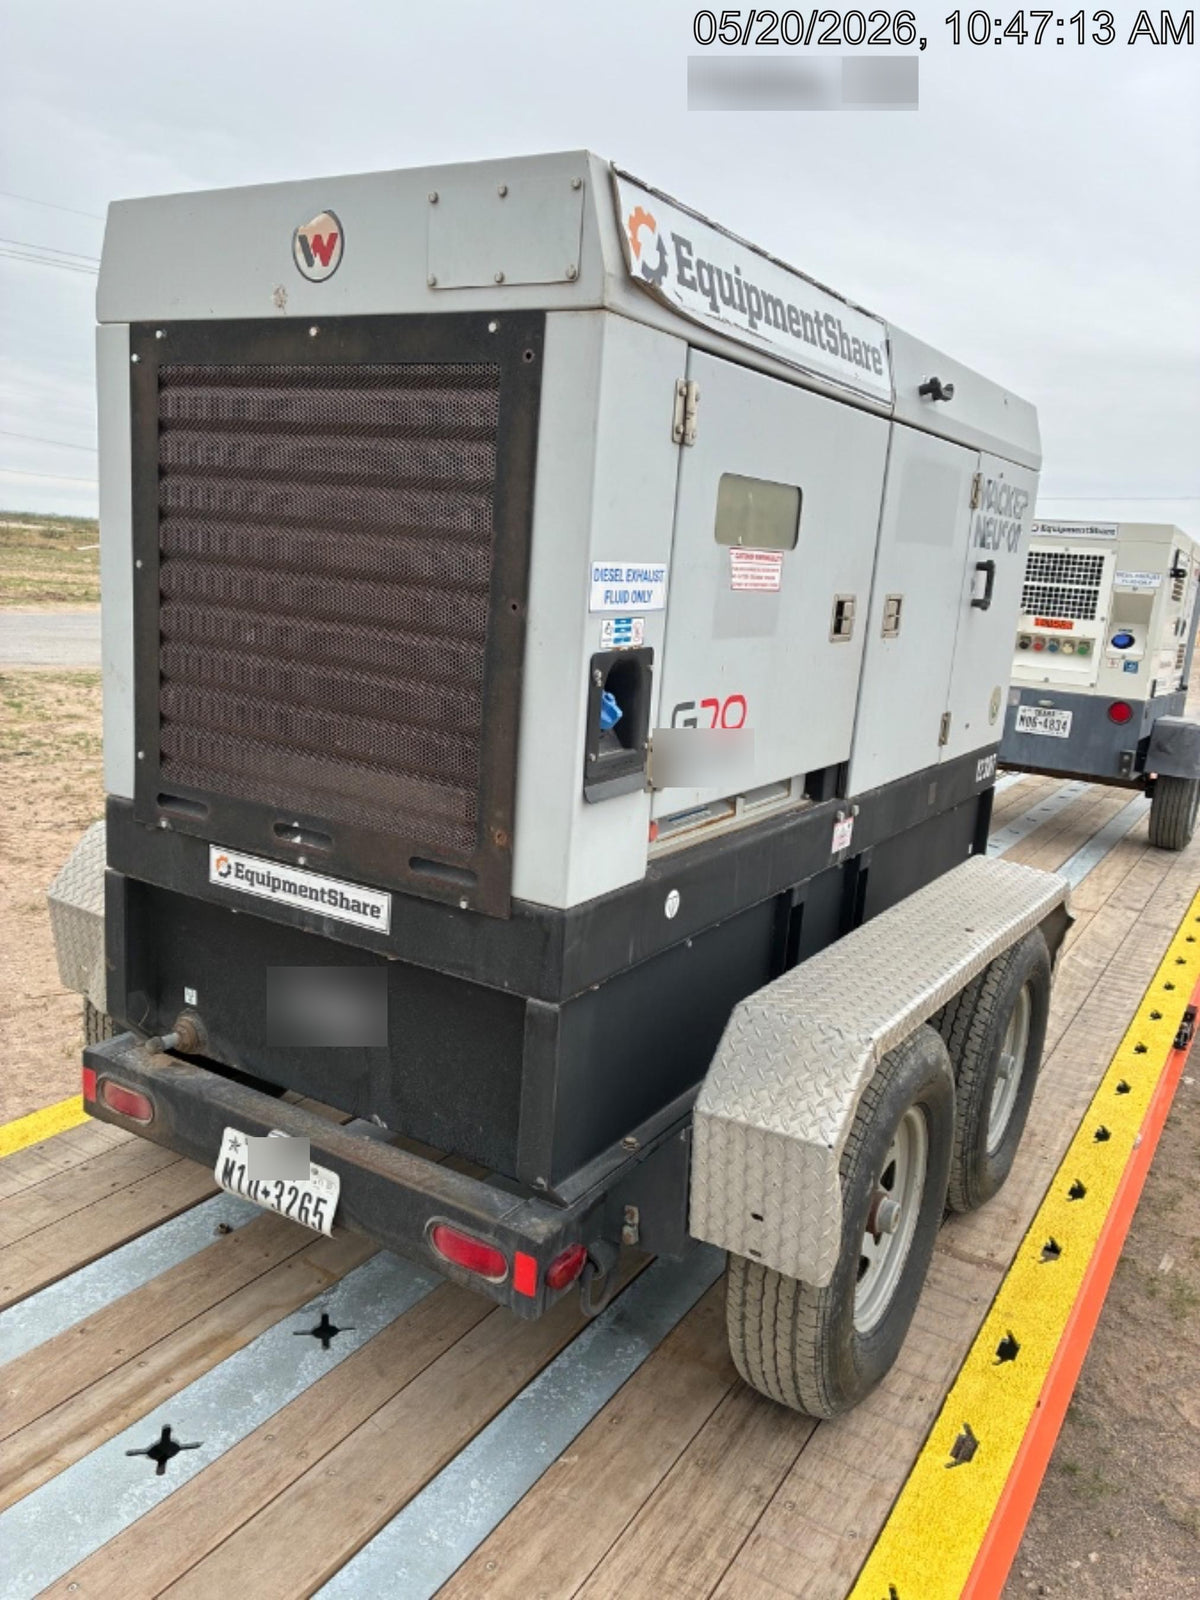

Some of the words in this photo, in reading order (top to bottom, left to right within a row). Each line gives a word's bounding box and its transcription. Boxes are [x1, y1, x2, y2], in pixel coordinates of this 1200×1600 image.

[671, 232, 884, 376] EquipmentShare
[593, 567, 624, 582] DIESEL
[626, 568, 664, 583] EXHAUST
[604, 589, 629, 604] FLUID
[631, 589, 653, 603] ONLY
[234, 861, 382, 920] EquipmentShare
